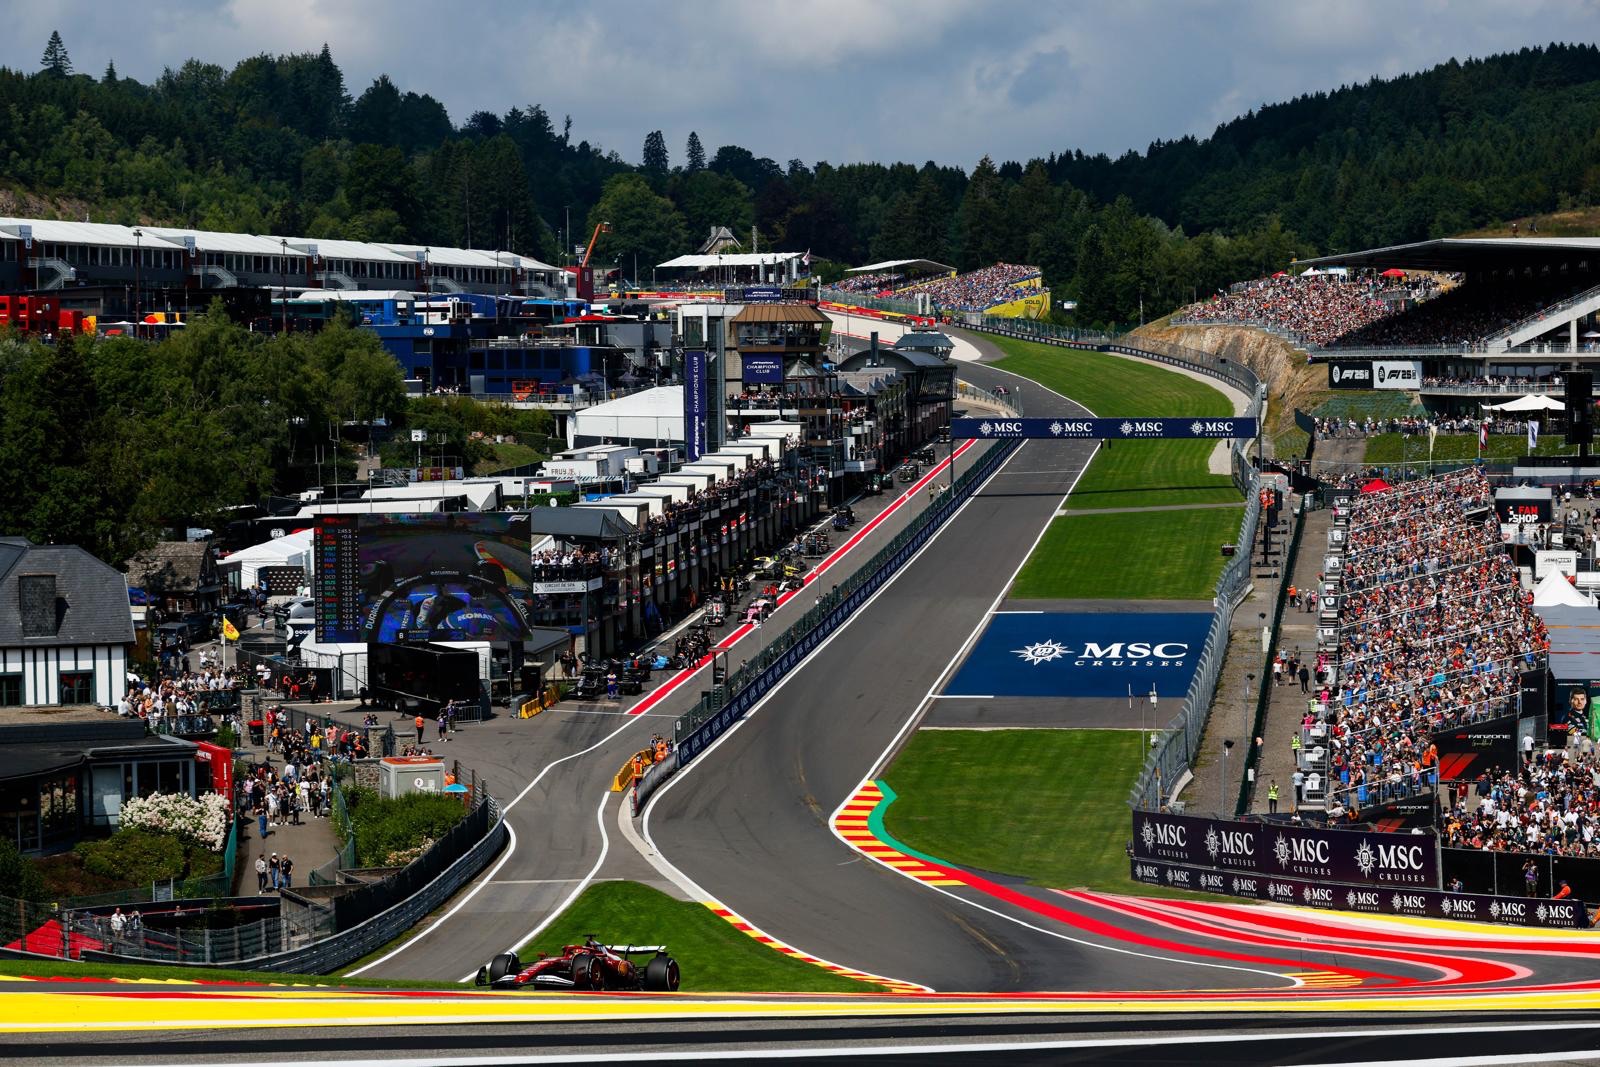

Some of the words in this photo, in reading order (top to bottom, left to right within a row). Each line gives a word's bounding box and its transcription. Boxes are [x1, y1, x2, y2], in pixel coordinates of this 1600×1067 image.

[1401, 370, 1411, 379] 25
[994, 422, 1022, 432] MSC
[1065, 422, 1092, 432] MSC
[1135, 422, 1163, 432] MSC
[1206, 422, 1233, 432] MSC
[1512, 514, 1538, 523] SHOP
[365, 599, 384, 629] DURACELL
[1078, 642, 1188, 659] MSC
[1156, 823, 1186, 847] MSC
[1221, 831, 1254, 855] MSC
[1158, 849, 1188, 859] CRUISES
[1291, 838, 1329, 863] MSC
[1223, 858, 1256, 867] CRUISES
[1378, 844, 1423, 870] MSC
[1143, 865, 1158, 877] MSC
[1174, 870, 1189, 882] MSC
[1294, 866, 1331, 875] CRUISES
[1208, 874, 1223, 886] MSC
[1379, 873, 1425, 882] CRUISES
[1240, 879, 1257, 891] MSC
[1276, 884, 1293, 896] MSC
[1312, 888, 1332, 900] MSC
[1358, 892, 1378, 904] MSC
[1404, 896, 1425, 908] MSC
[1453, 900, 1475, 912] MSC
[1502, 903, 1525, 916] MSC
[1549, 906, 1573, 918] MSC
